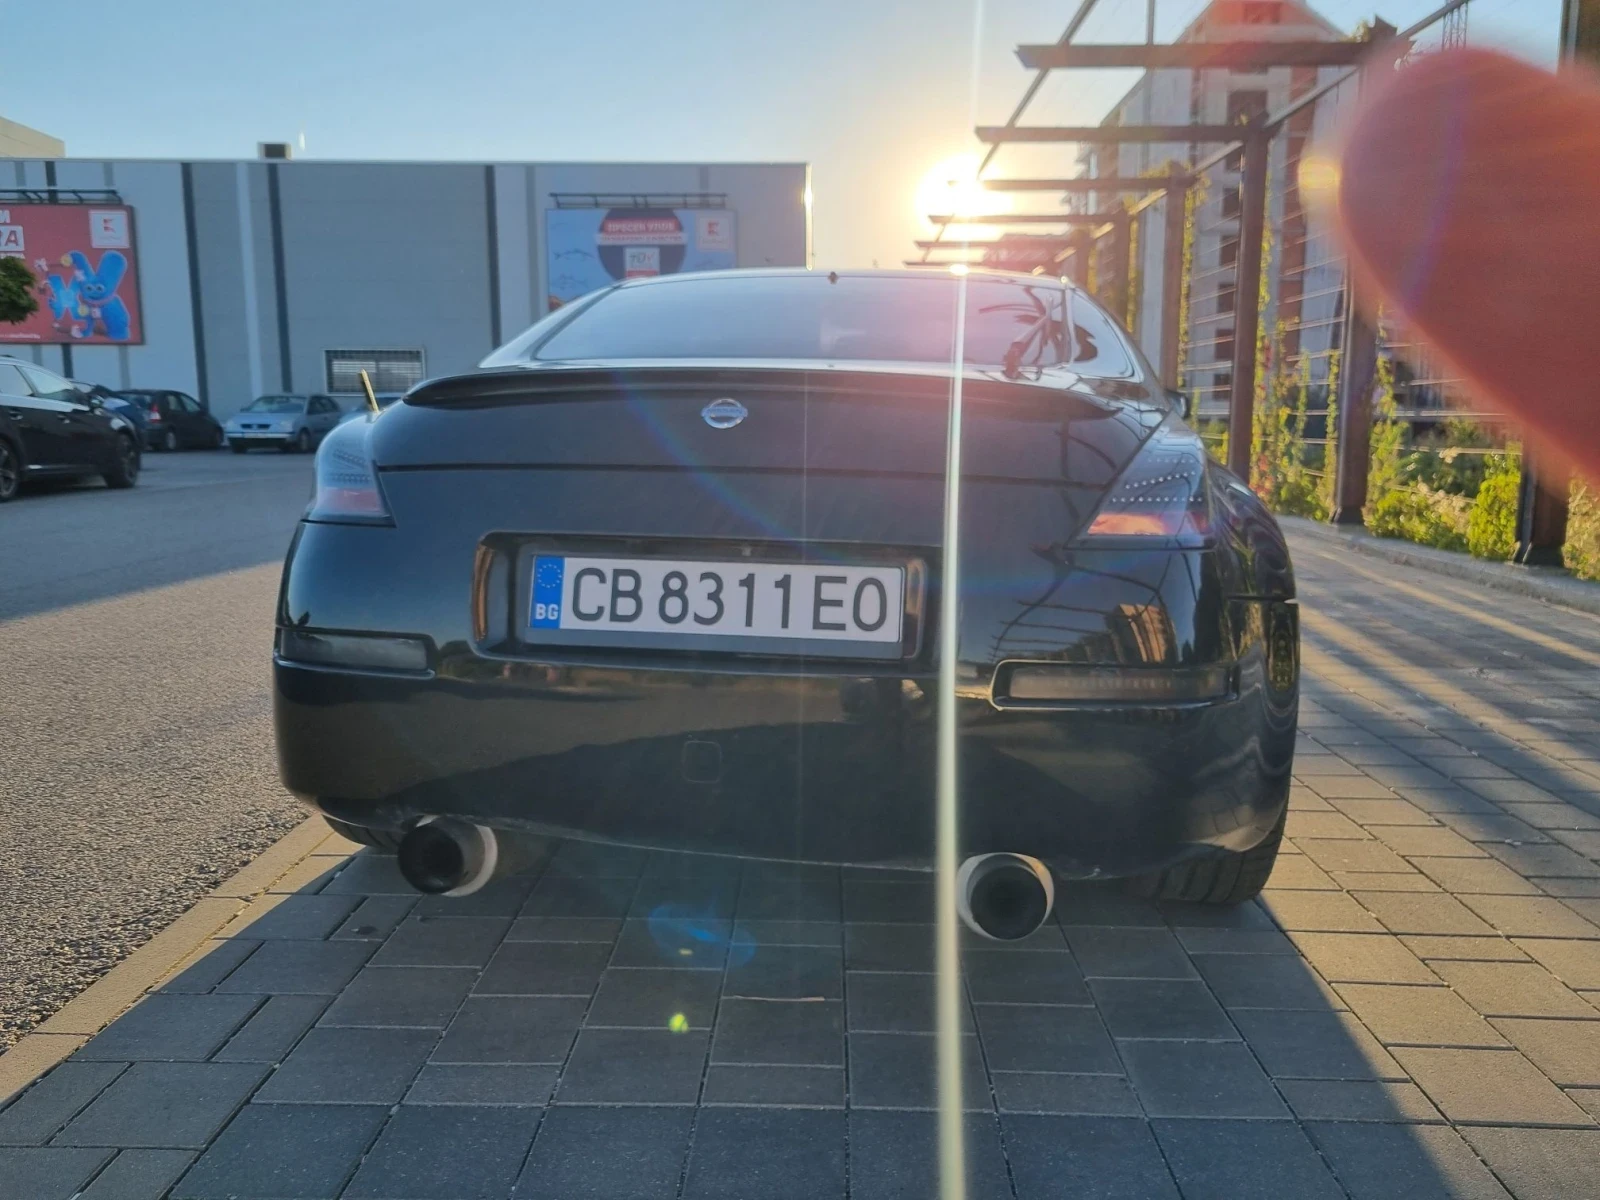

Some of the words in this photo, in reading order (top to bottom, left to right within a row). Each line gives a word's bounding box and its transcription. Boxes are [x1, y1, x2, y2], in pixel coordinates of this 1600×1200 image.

[535, 603, 559, 621] BG
[571, 567, 643, 624] CB
[658, 570, 791, 629] 8311
